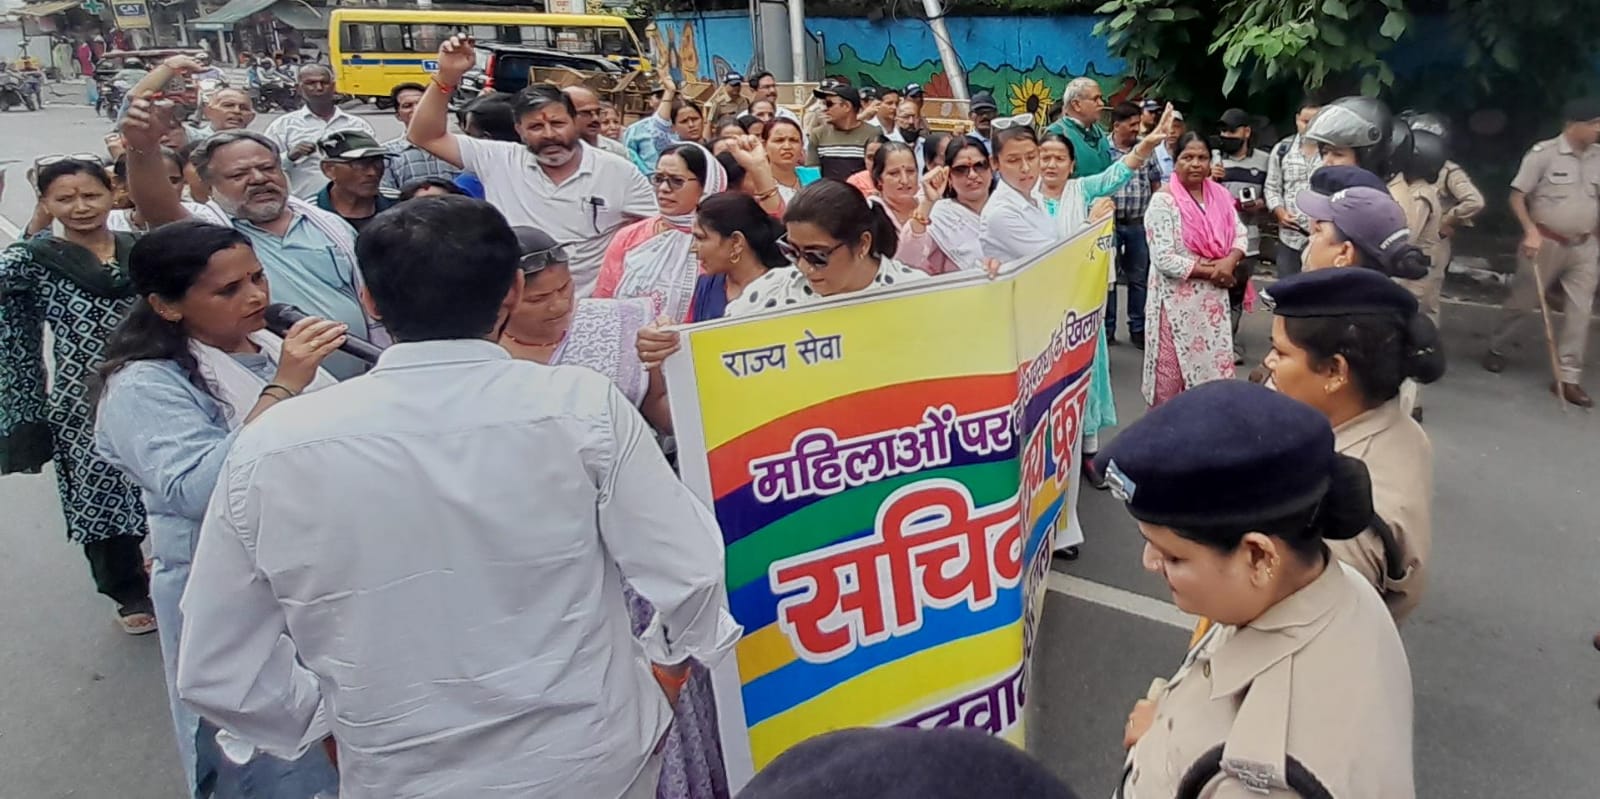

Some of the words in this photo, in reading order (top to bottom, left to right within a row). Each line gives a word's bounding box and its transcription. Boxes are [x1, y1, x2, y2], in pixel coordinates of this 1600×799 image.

[723, 344, 786, 377] राज्य
[795, 330, 841, 365] सेवा
[752, 408, 952, 498] महिलाओं
[959, 408, 1012, 451] पर
